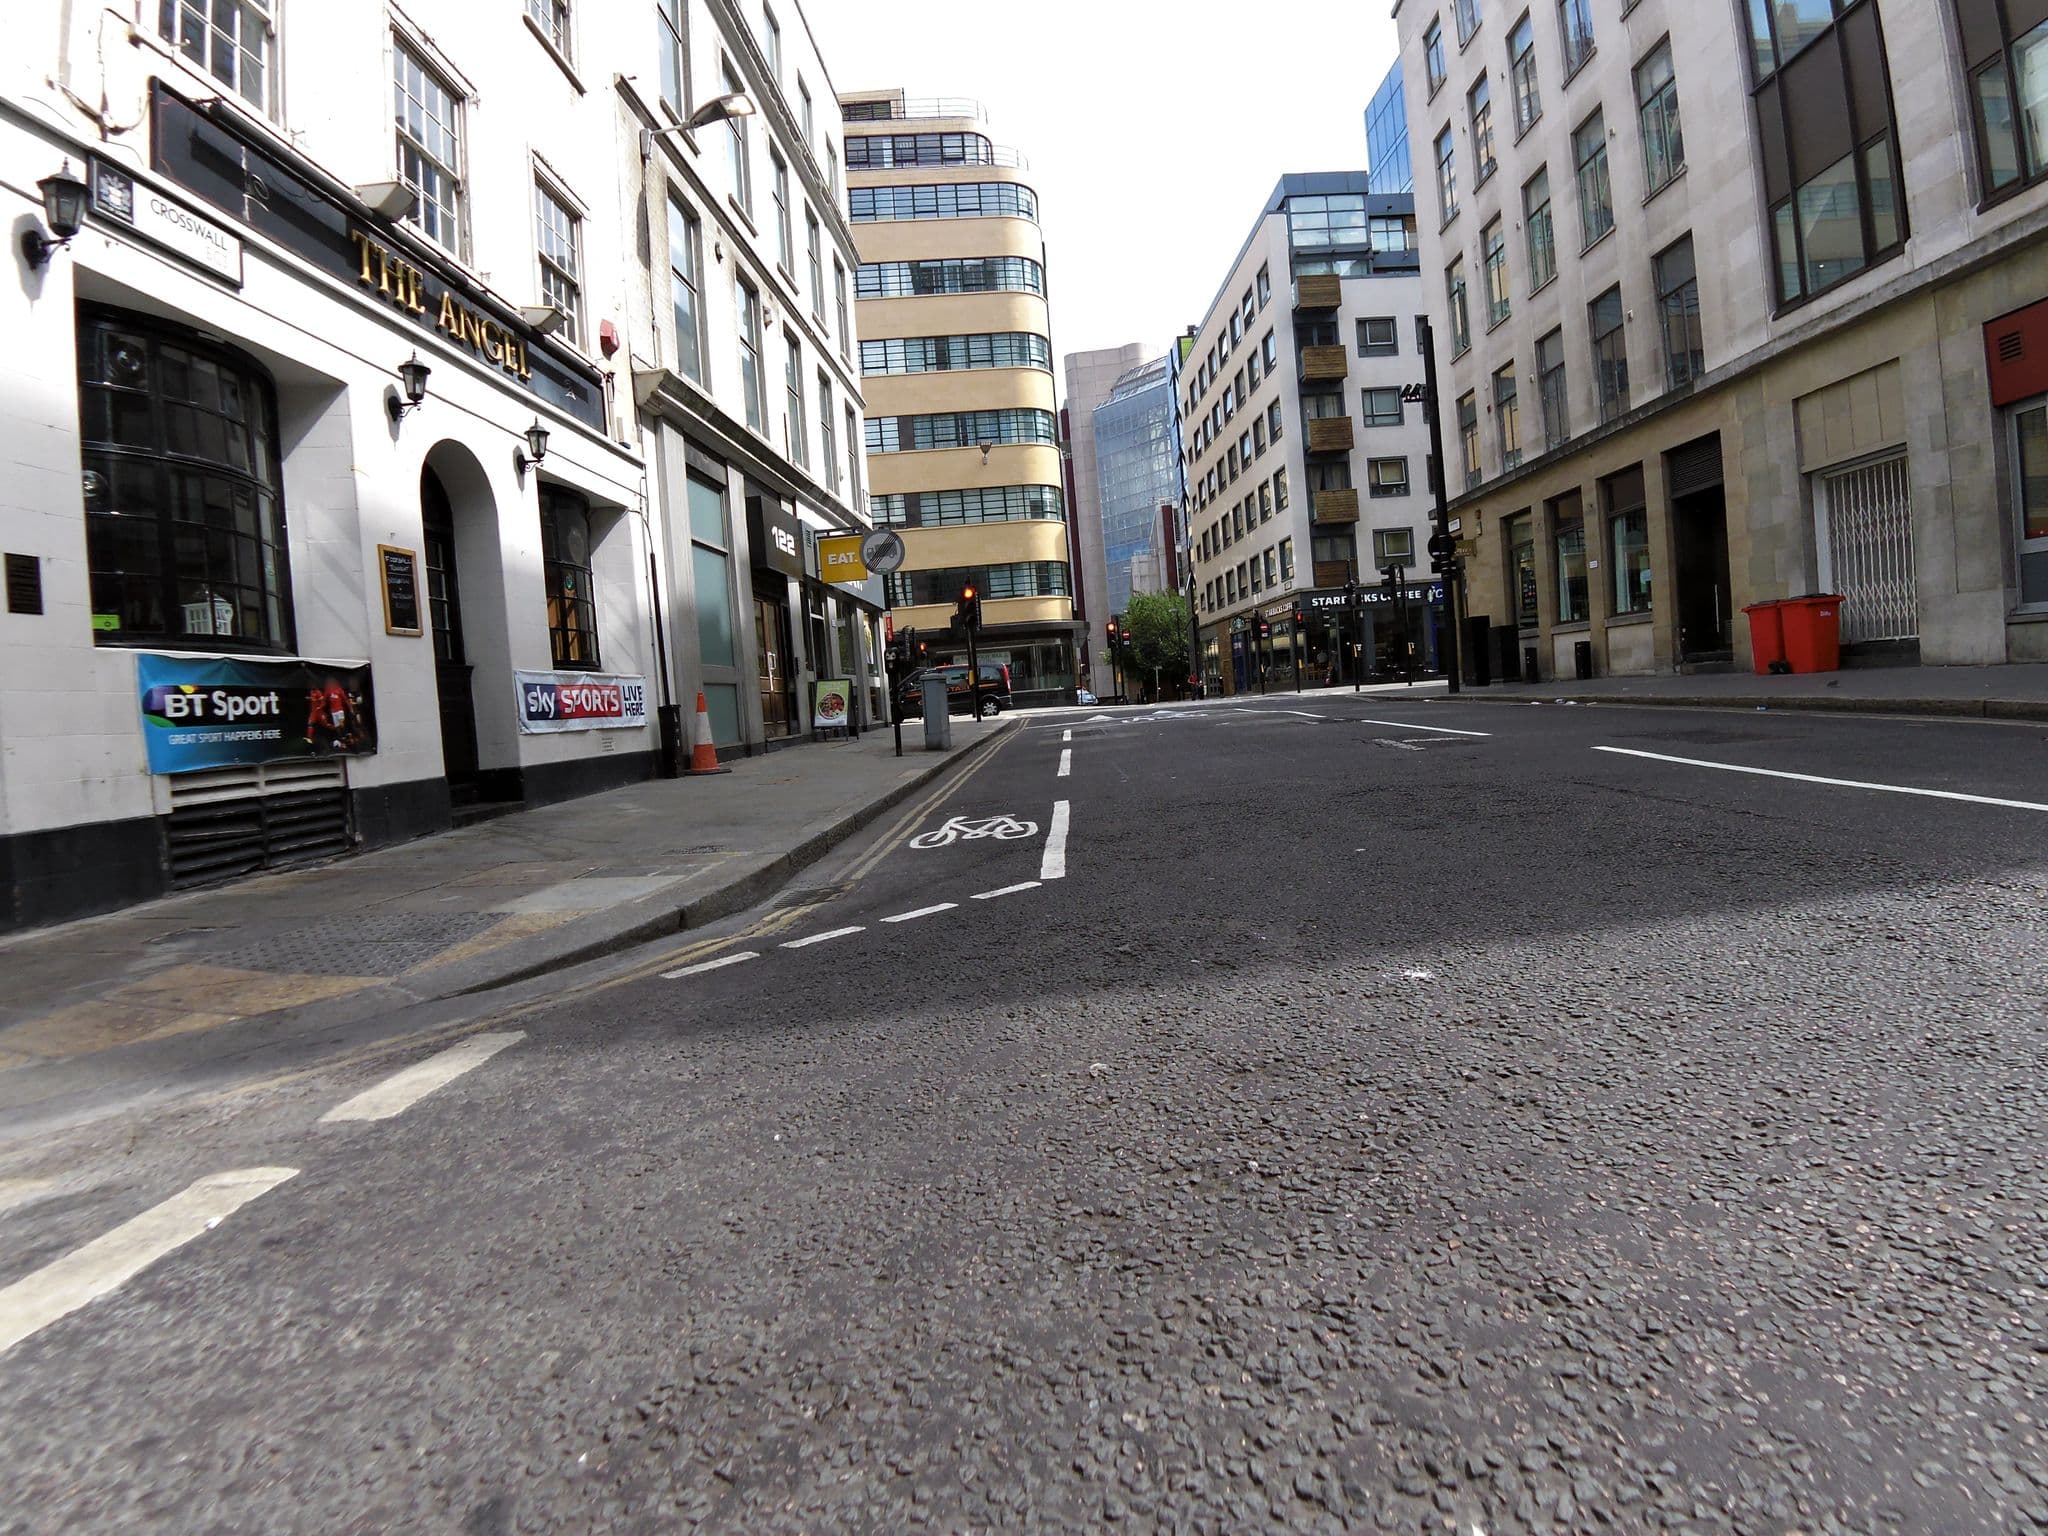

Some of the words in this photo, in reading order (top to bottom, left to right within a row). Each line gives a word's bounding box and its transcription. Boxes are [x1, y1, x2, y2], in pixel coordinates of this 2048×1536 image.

[150, 198, 229, 251] CROSSWALL
[352, 229, 425, 315] THE
[437, 291, 533, 381] ANGEL
[771, 525, 796, 558] 122
[1311, 593, 1378, 607] STARBKS
[164, 692, 208, 718] BT
[213, 690, 280, 721] Sport
[527, 685, 556, 720] sky
[560, 688, 620, 714] SPORTS
[623, 685, 643, 702] LIVE
[624, 702, 645, 717] HERE
[168, 732, 197, 746] GREAT
[199, 731, 223, 745] SPORT
[223, 729, 263, 743] HAPPENS
[263, 728, 282, 741] HERE
